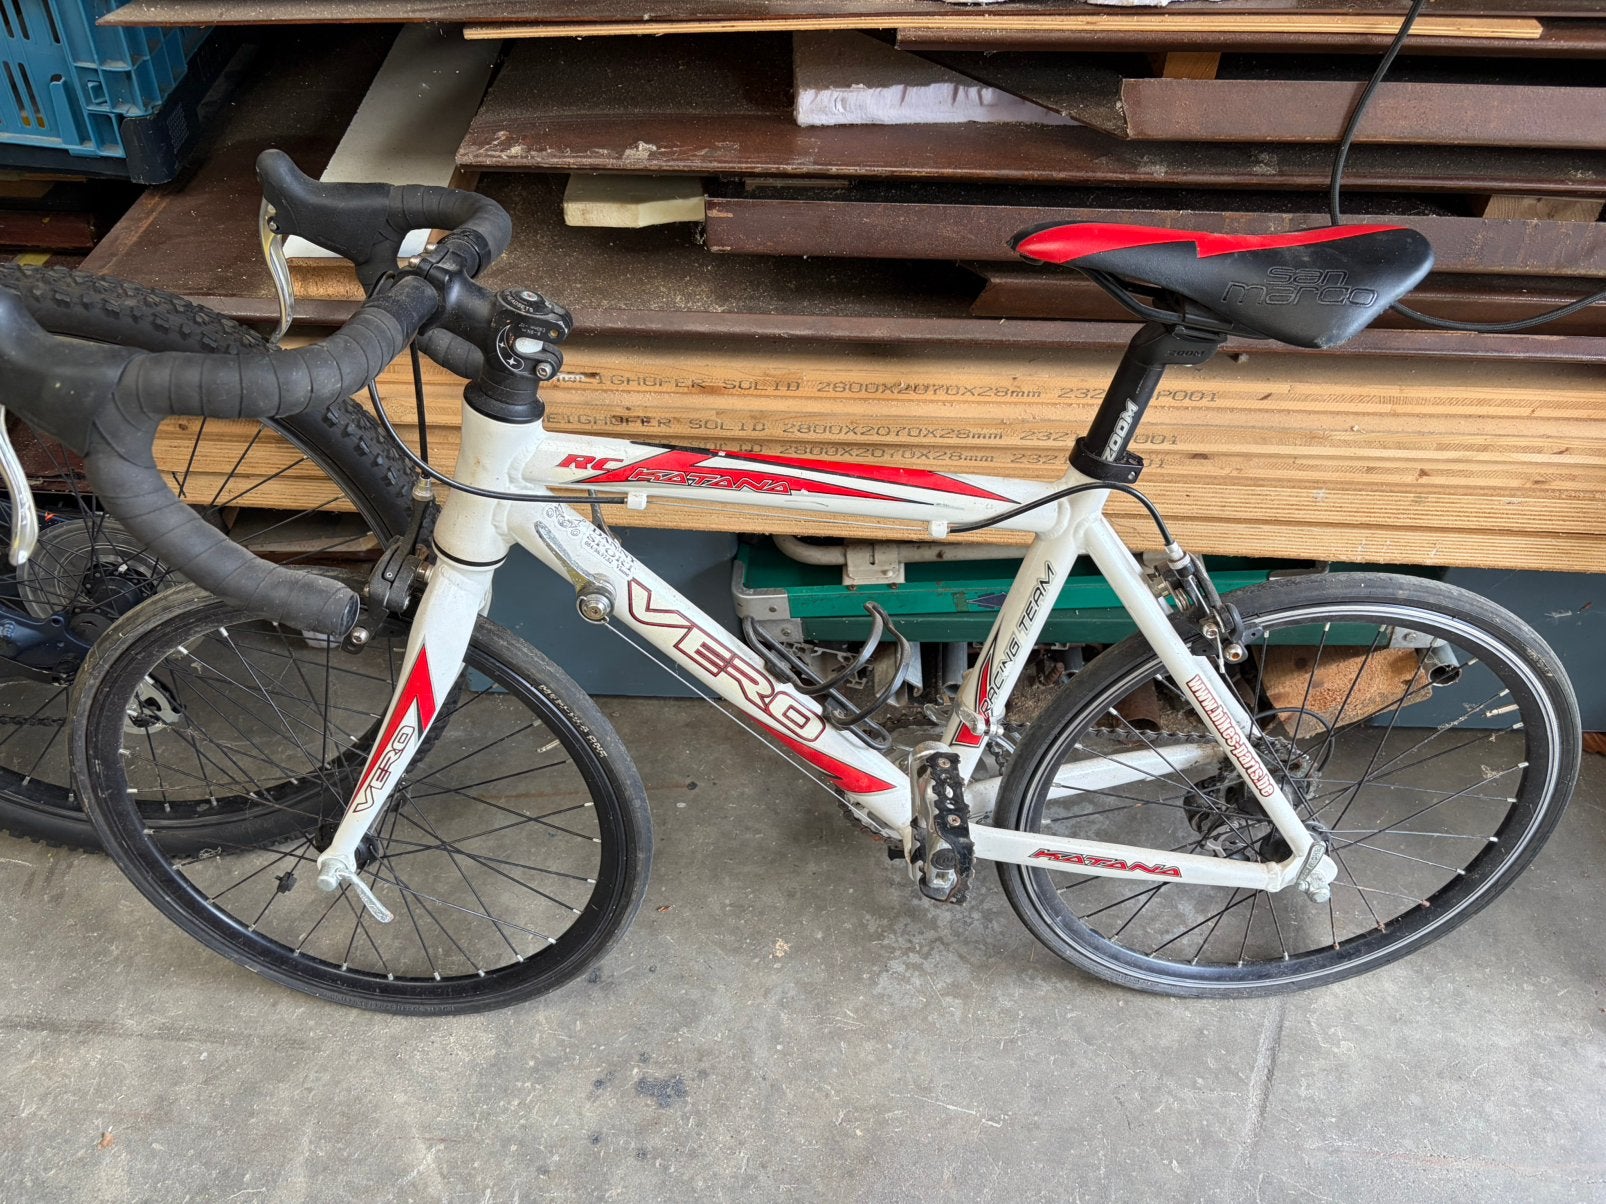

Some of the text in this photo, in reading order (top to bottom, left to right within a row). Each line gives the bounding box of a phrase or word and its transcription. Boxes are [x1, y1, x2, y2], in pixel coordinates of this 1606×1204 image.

[1266, 266, 1349, 287] san
[1220, 281, 1378, 308] marco
[722, 379, 801, 392] SOLID
[688, 418, 766, 433] SOLID
[1101, 398, 1139, 462] ZOOM
[555, 453, 625, 472] RC
[627, 467, 793, 495] KATANA
[586, 534, 633, 572] SPORT
[979, 560, 1057, 719] RACING TEAM
[627, 576, 827, 743] VERO
[1185, 673, 1275, 798] www.bikes-parts.be
[352, 725, 416, 814] VERO
[1028, 848, 1183, 879] KATANA
